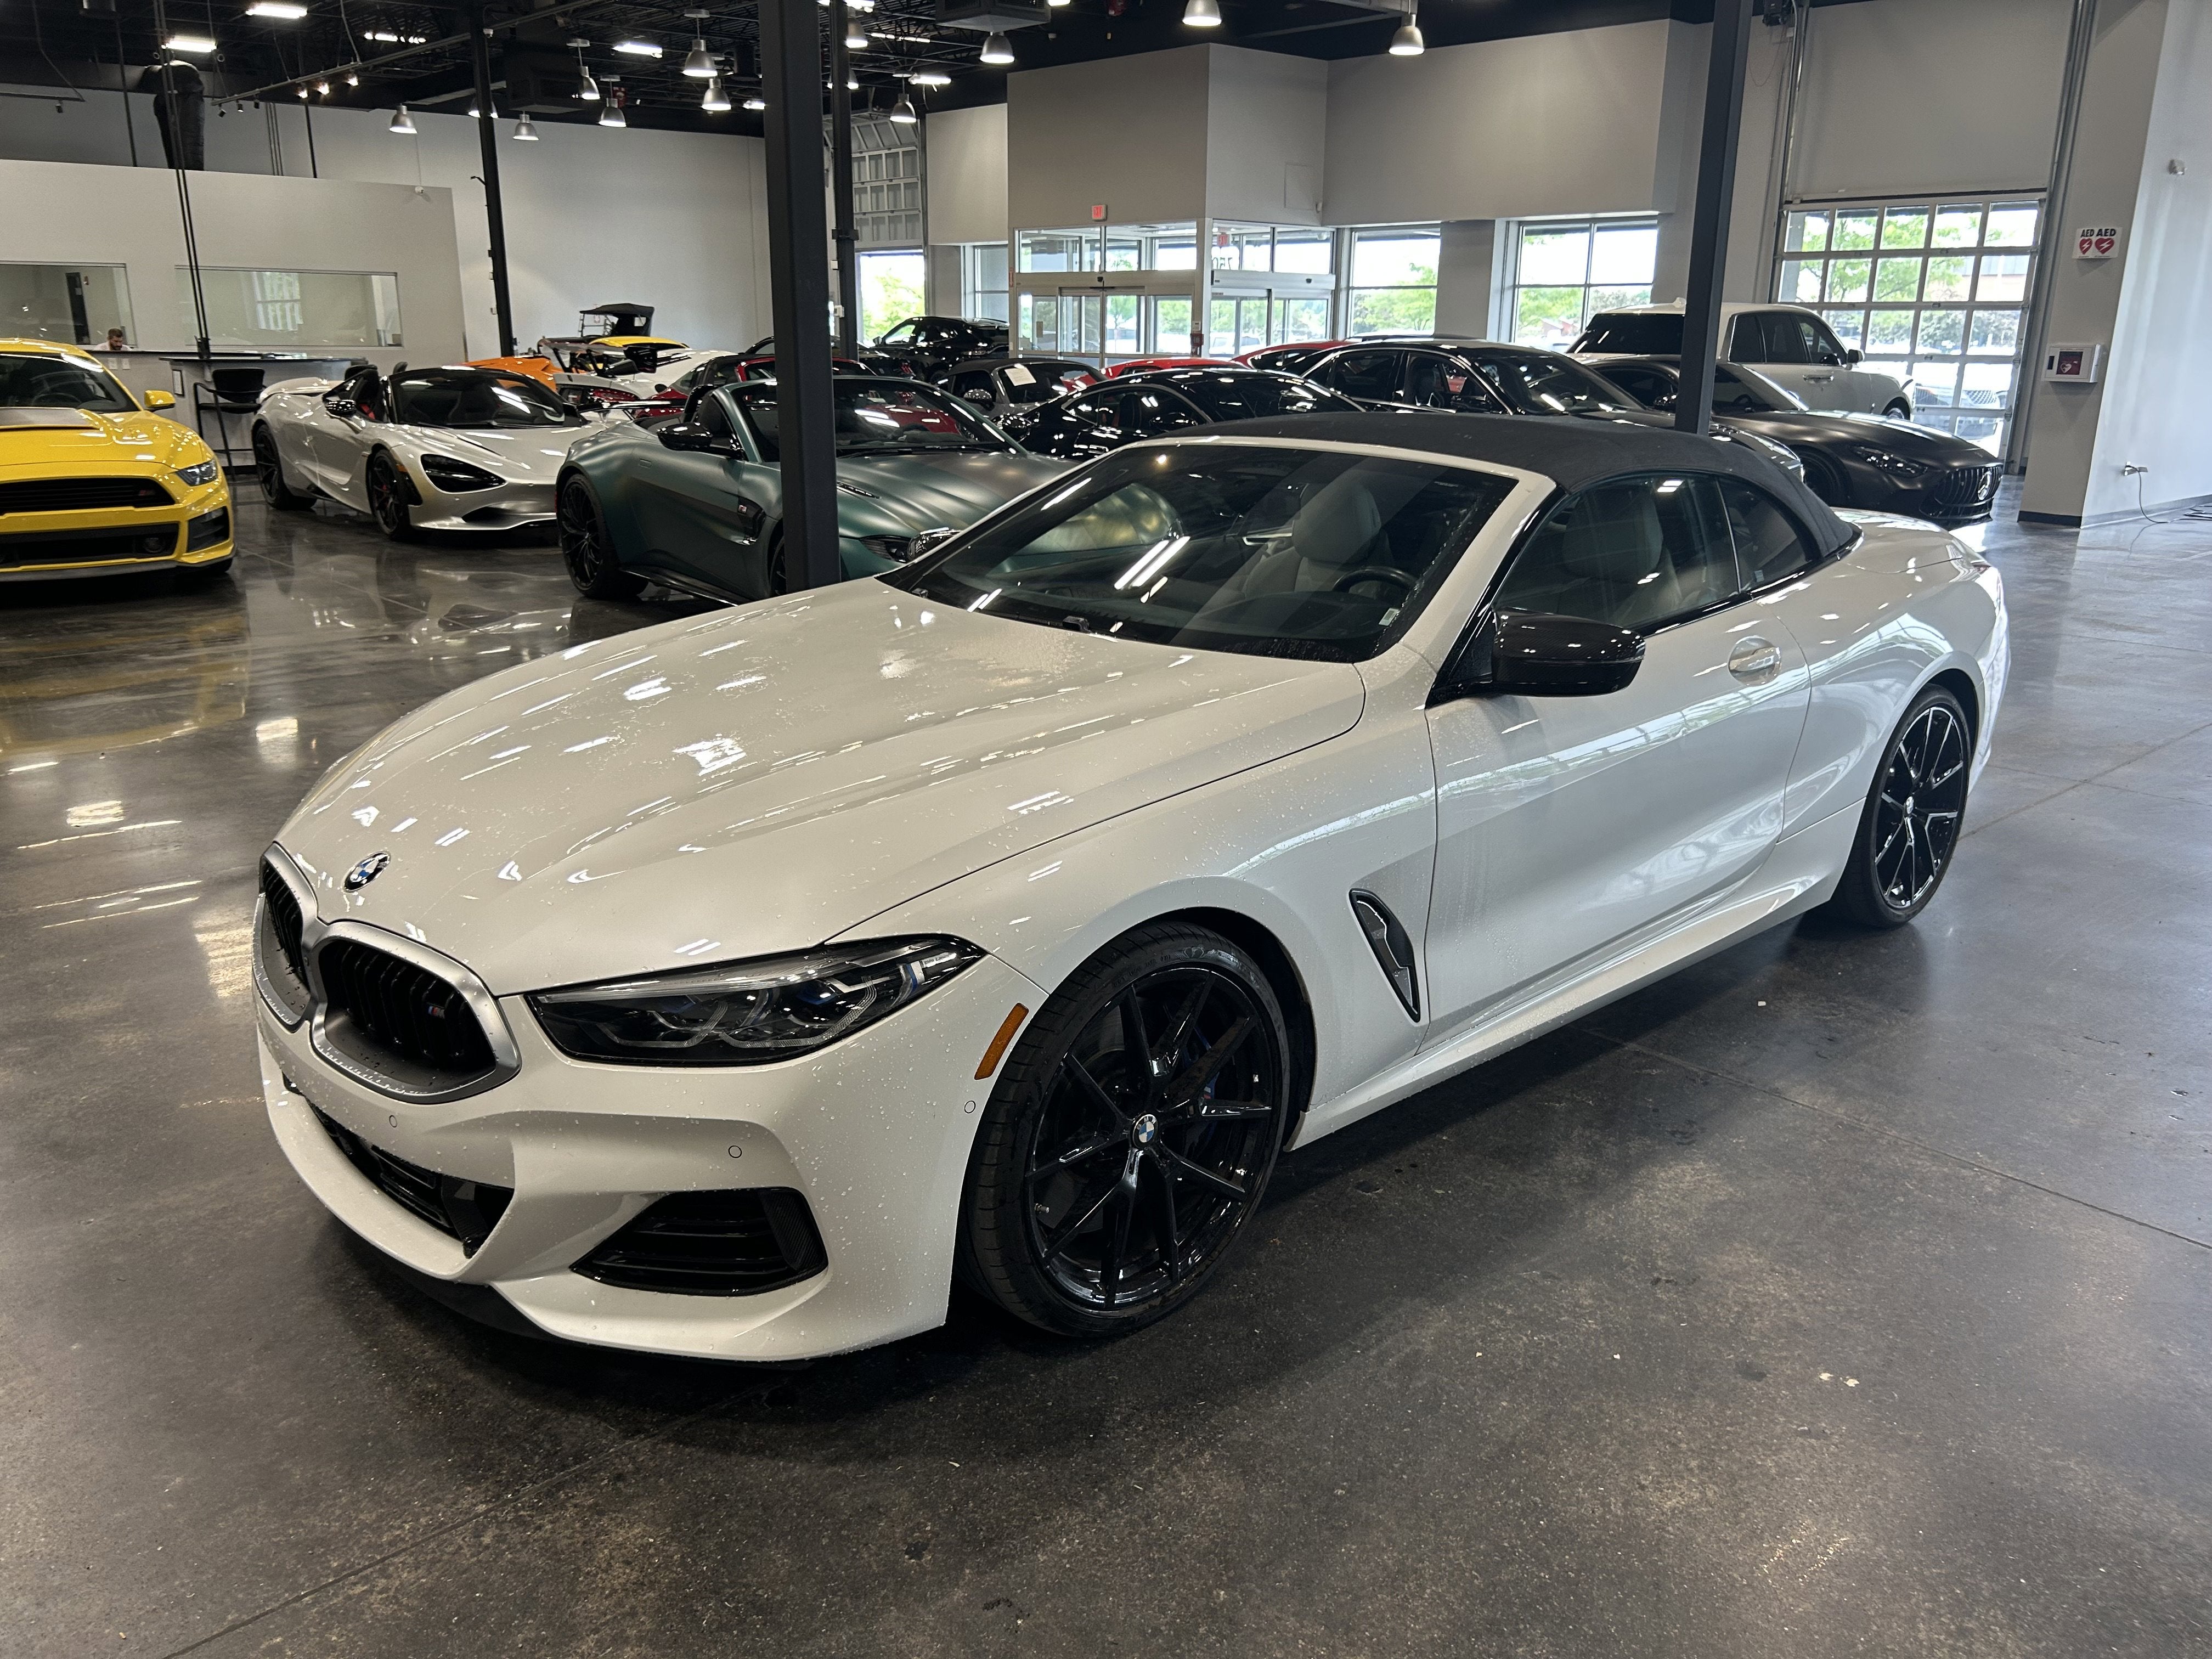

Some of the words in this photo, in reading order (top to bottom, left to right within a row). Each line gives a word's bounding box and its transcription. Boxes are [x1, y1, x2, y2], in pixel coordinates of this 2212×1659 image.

[2080, 229, 2095, 238] AED
[2096, 228, 2117, 236] AED
[1137, 1116, 1156, 1130] BMW
